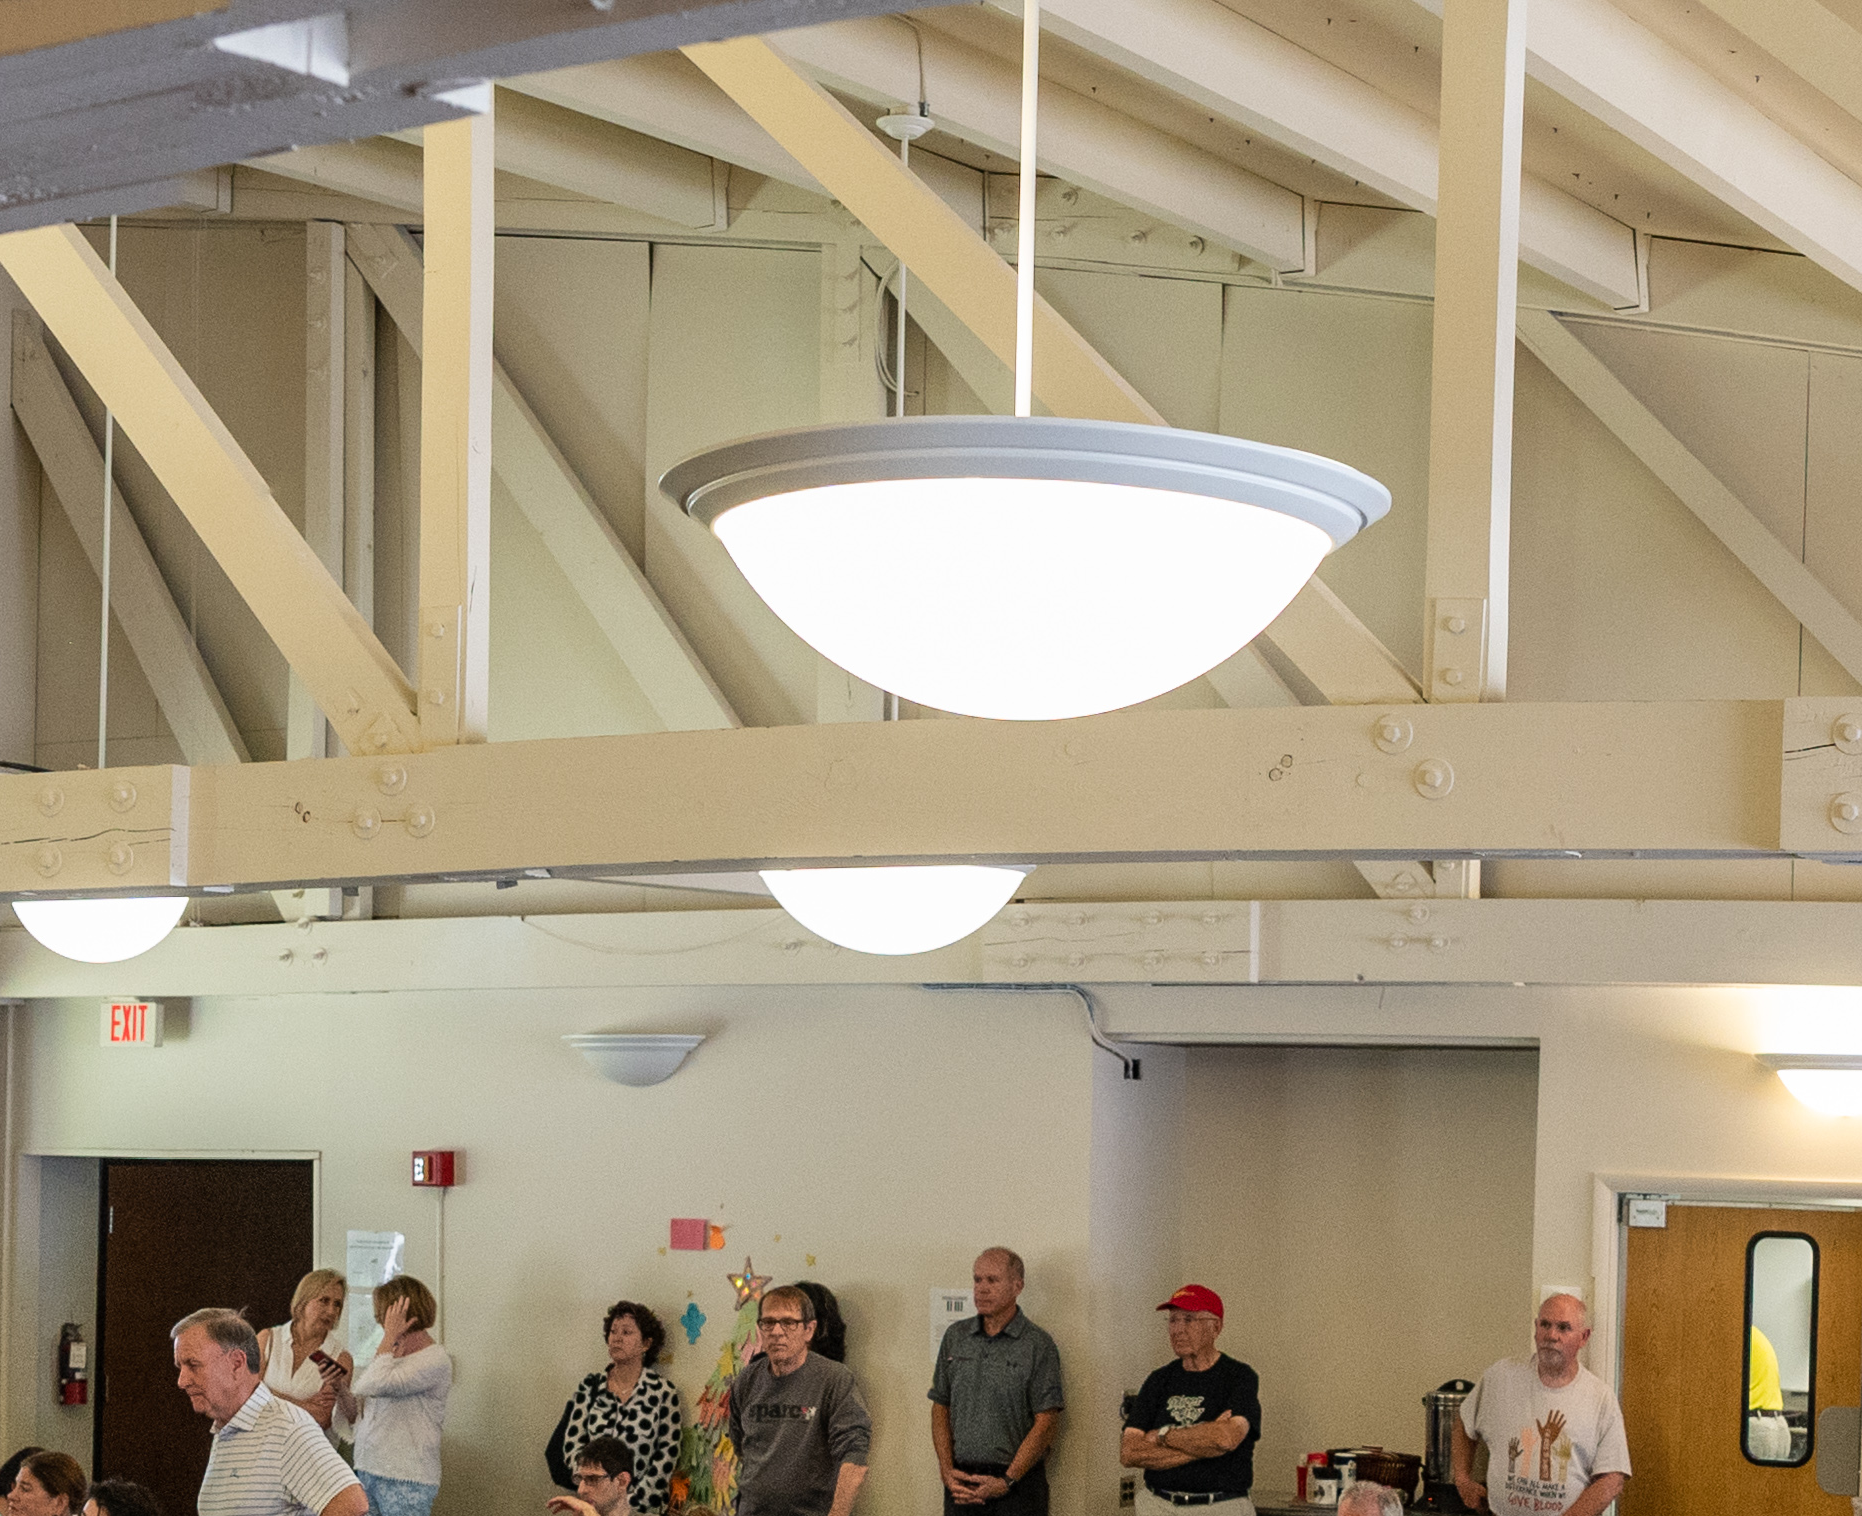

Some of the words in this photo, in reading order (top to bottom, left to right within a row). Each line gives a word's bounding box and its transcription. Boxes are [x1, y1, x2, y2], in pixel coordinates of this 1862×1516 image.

[111, 1004, 148, 1042] EXIT
[749, 1403, 800, 1422] sparc
[1508, 1492, 1531, 1509] GIVE
[1533, 1497, 1564, 1512] BLOOD
